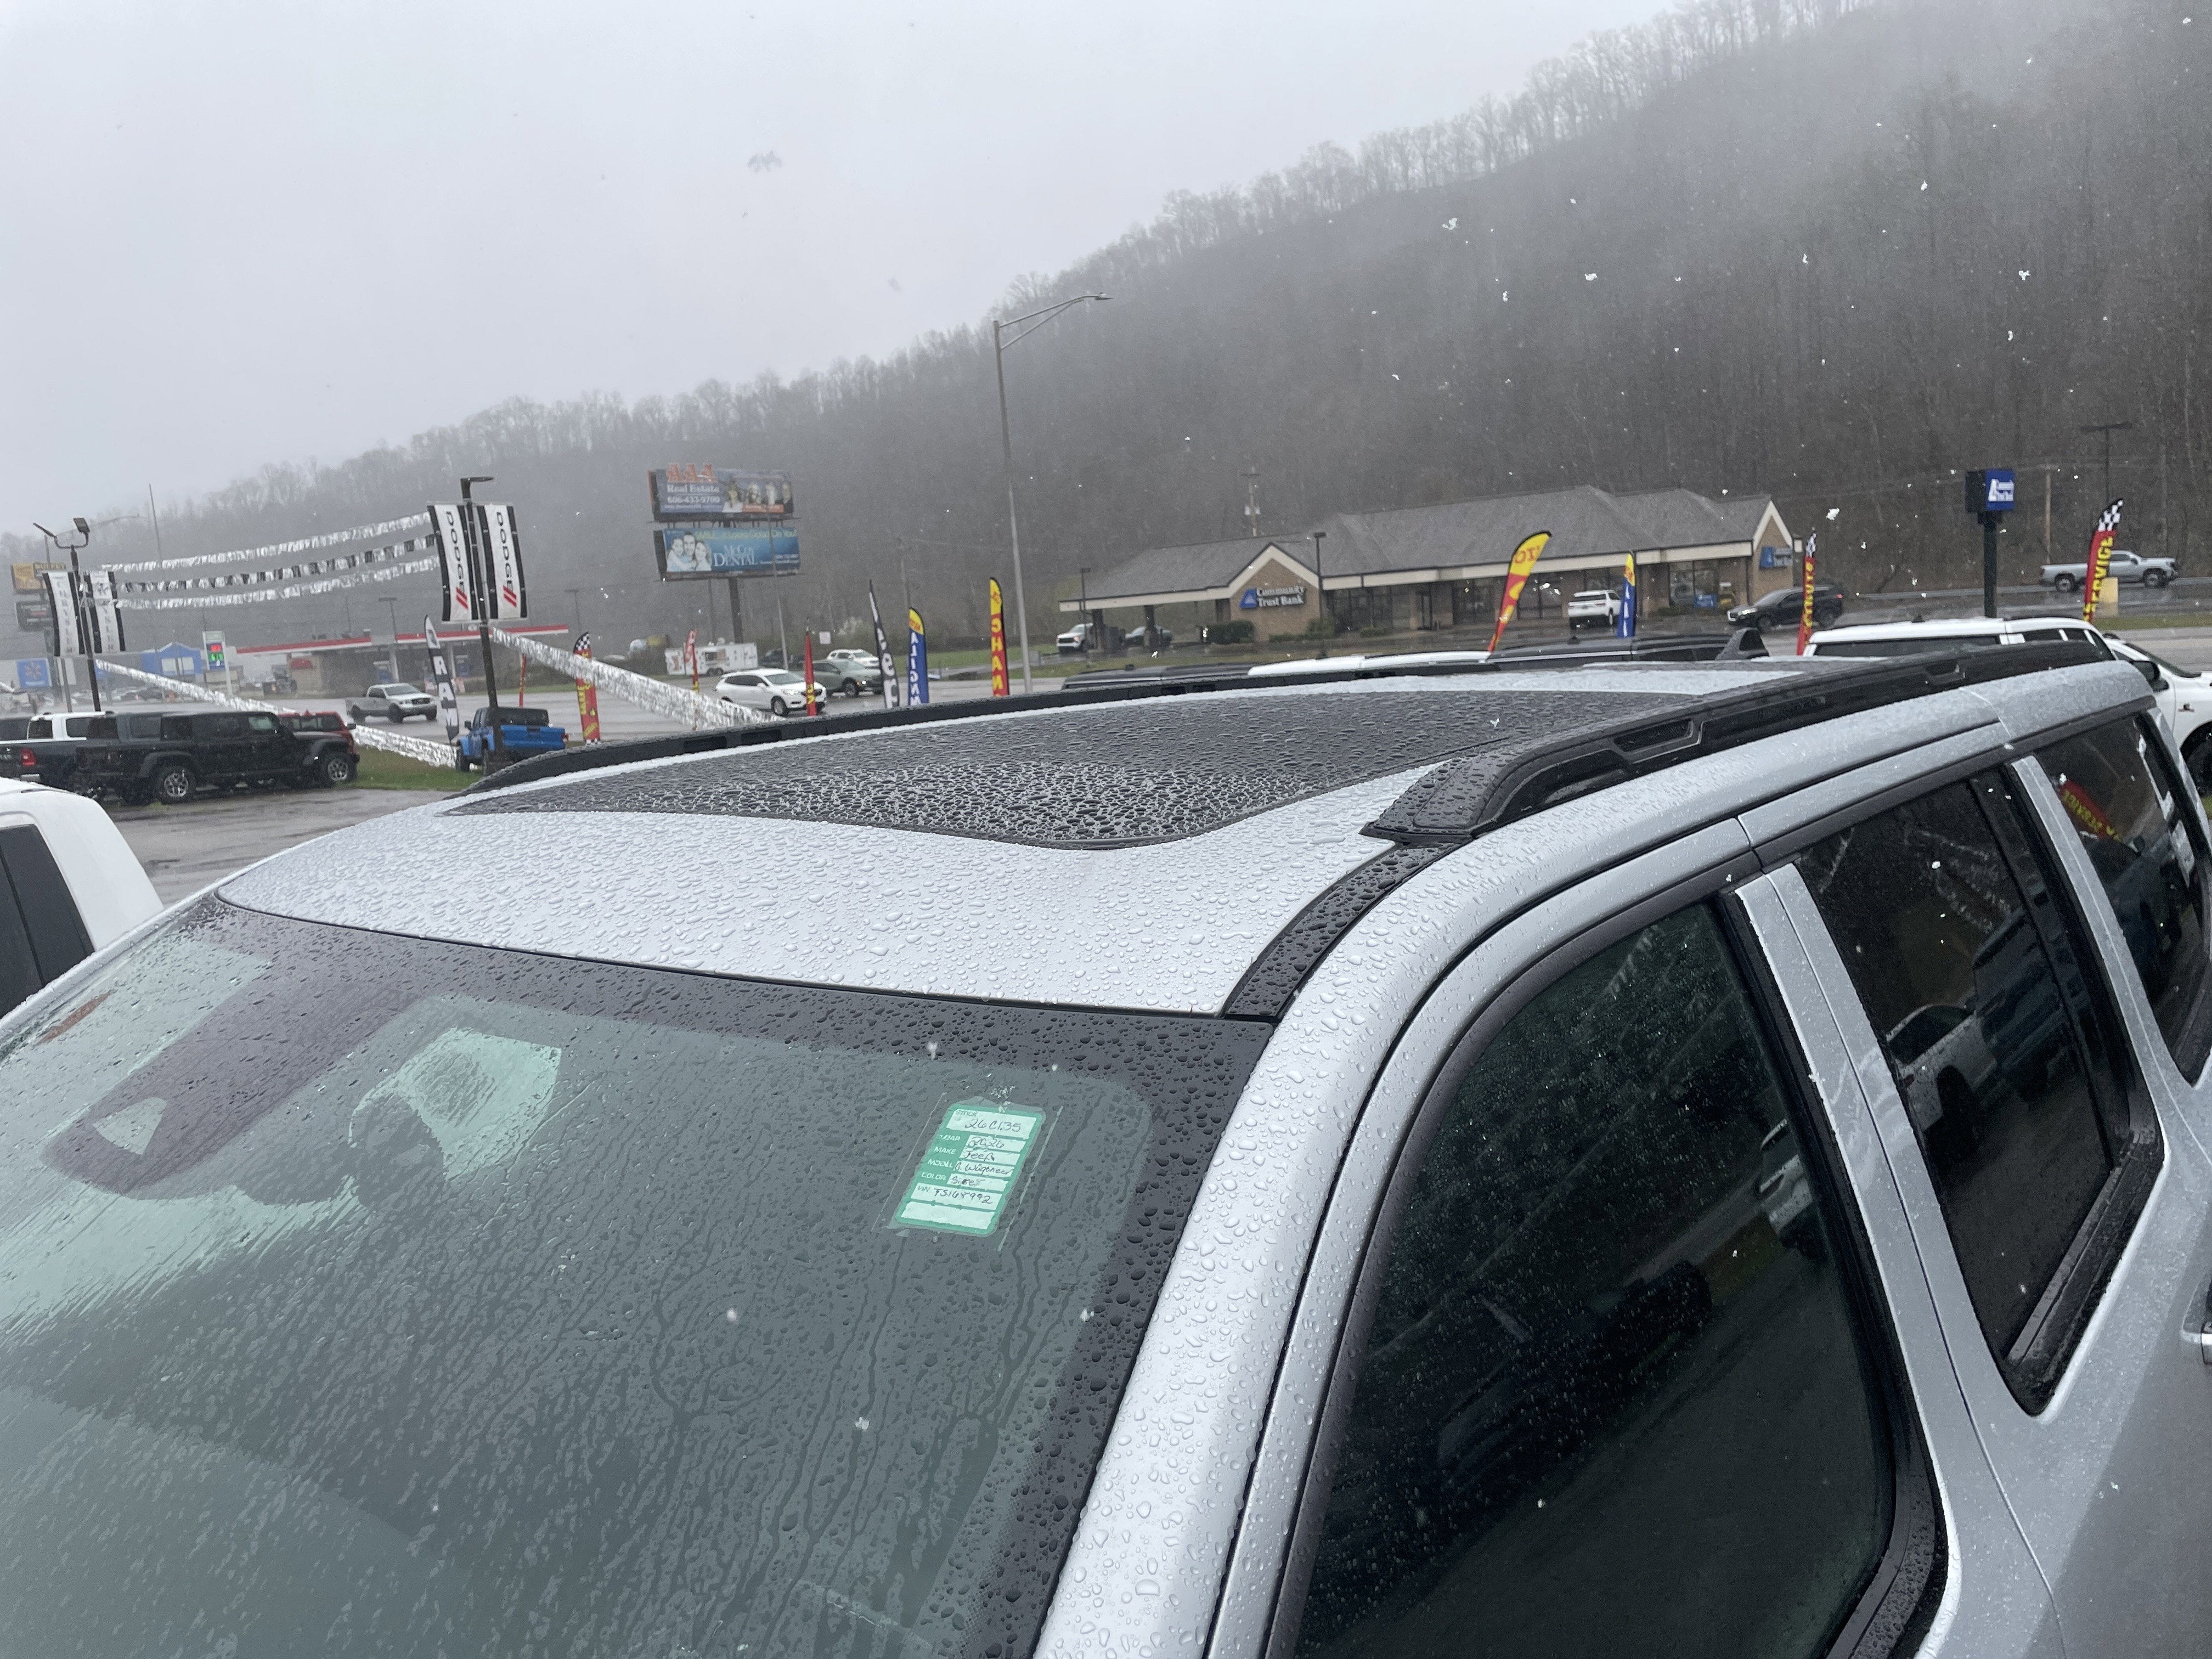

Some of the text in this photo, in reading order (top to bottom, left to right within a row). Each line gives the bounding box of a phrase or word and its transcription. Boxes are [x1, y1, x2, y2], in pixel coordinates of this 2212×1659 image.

[667, 484, 687, 493] Real
[446, 511, 464, 595] DODGE
[496, 511, 514, 593] DODGE
[934, 1146, 957, 1154] MAKE
[921, 1172, 946, 1181] COLOR
